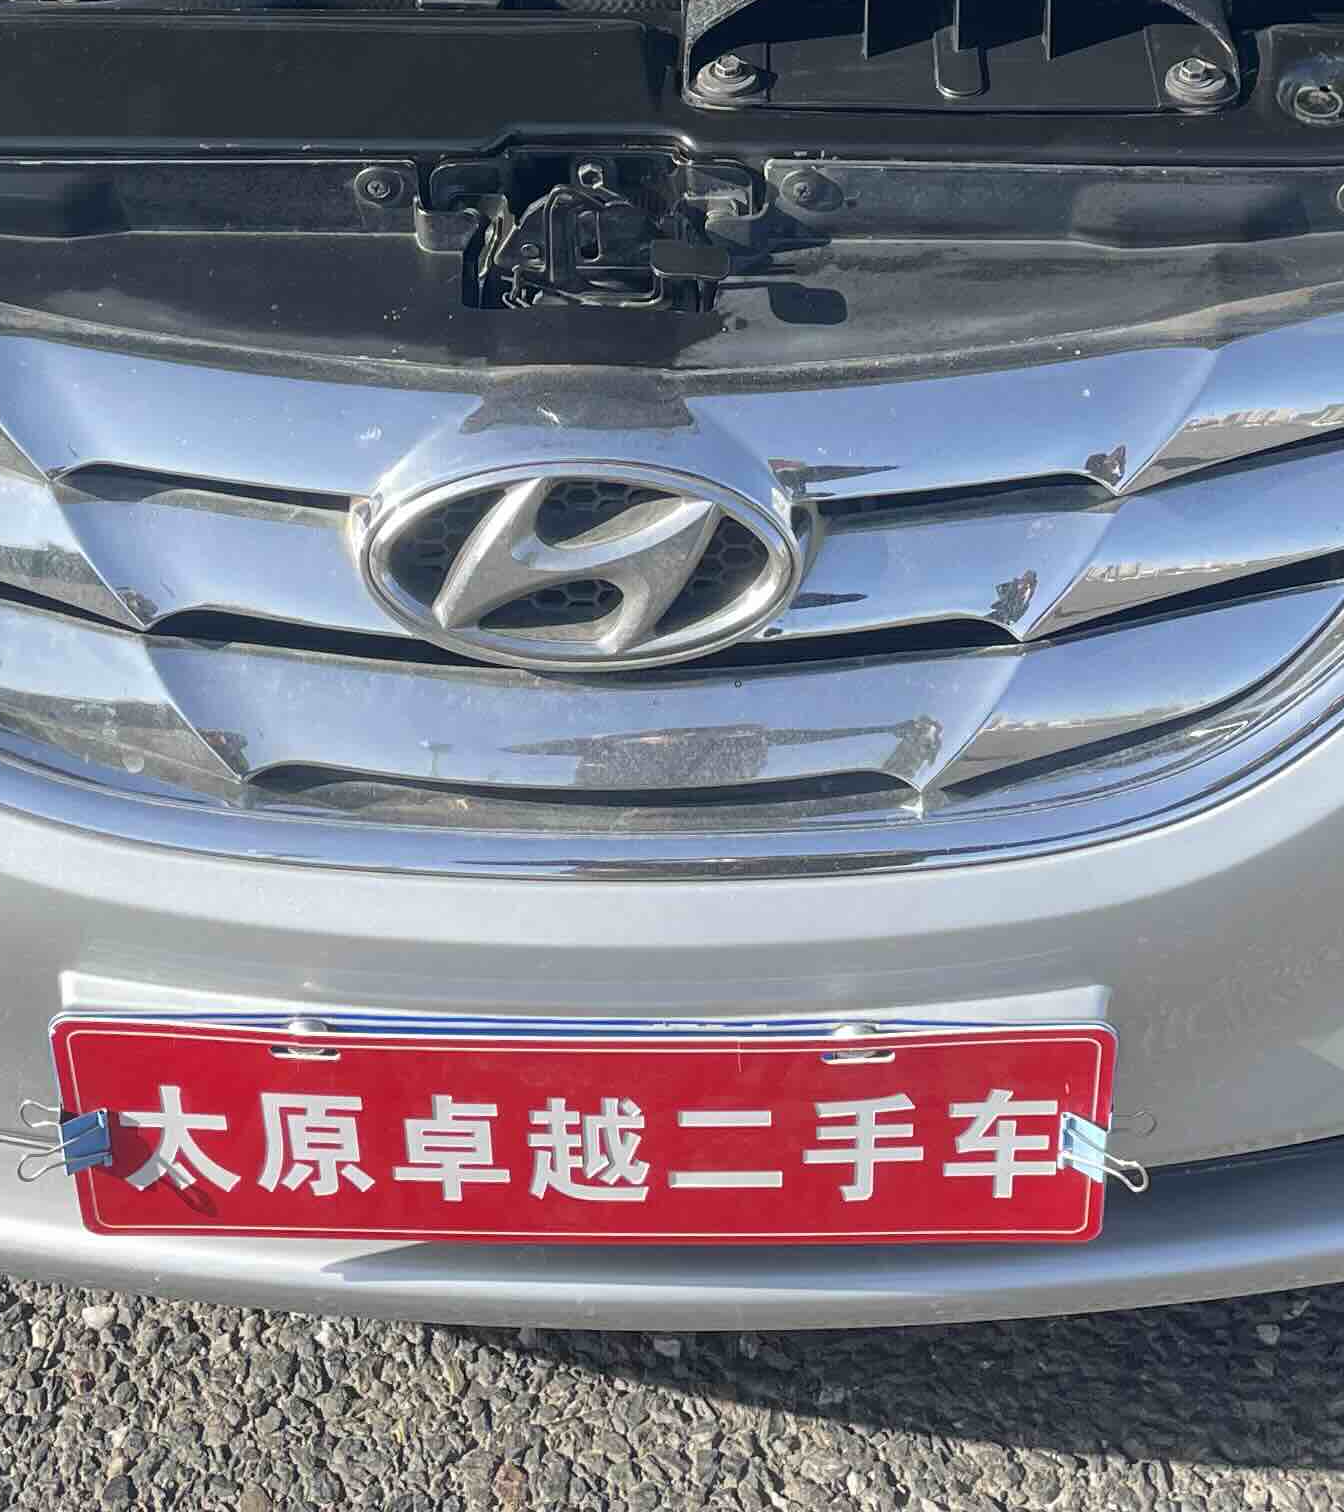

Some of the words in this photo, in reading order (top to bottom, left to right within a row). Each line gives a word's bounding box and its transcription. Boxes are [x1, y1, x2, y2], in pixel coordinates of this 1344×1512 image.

[119, 1084, 1059, 1203] 太原卓越二手车
